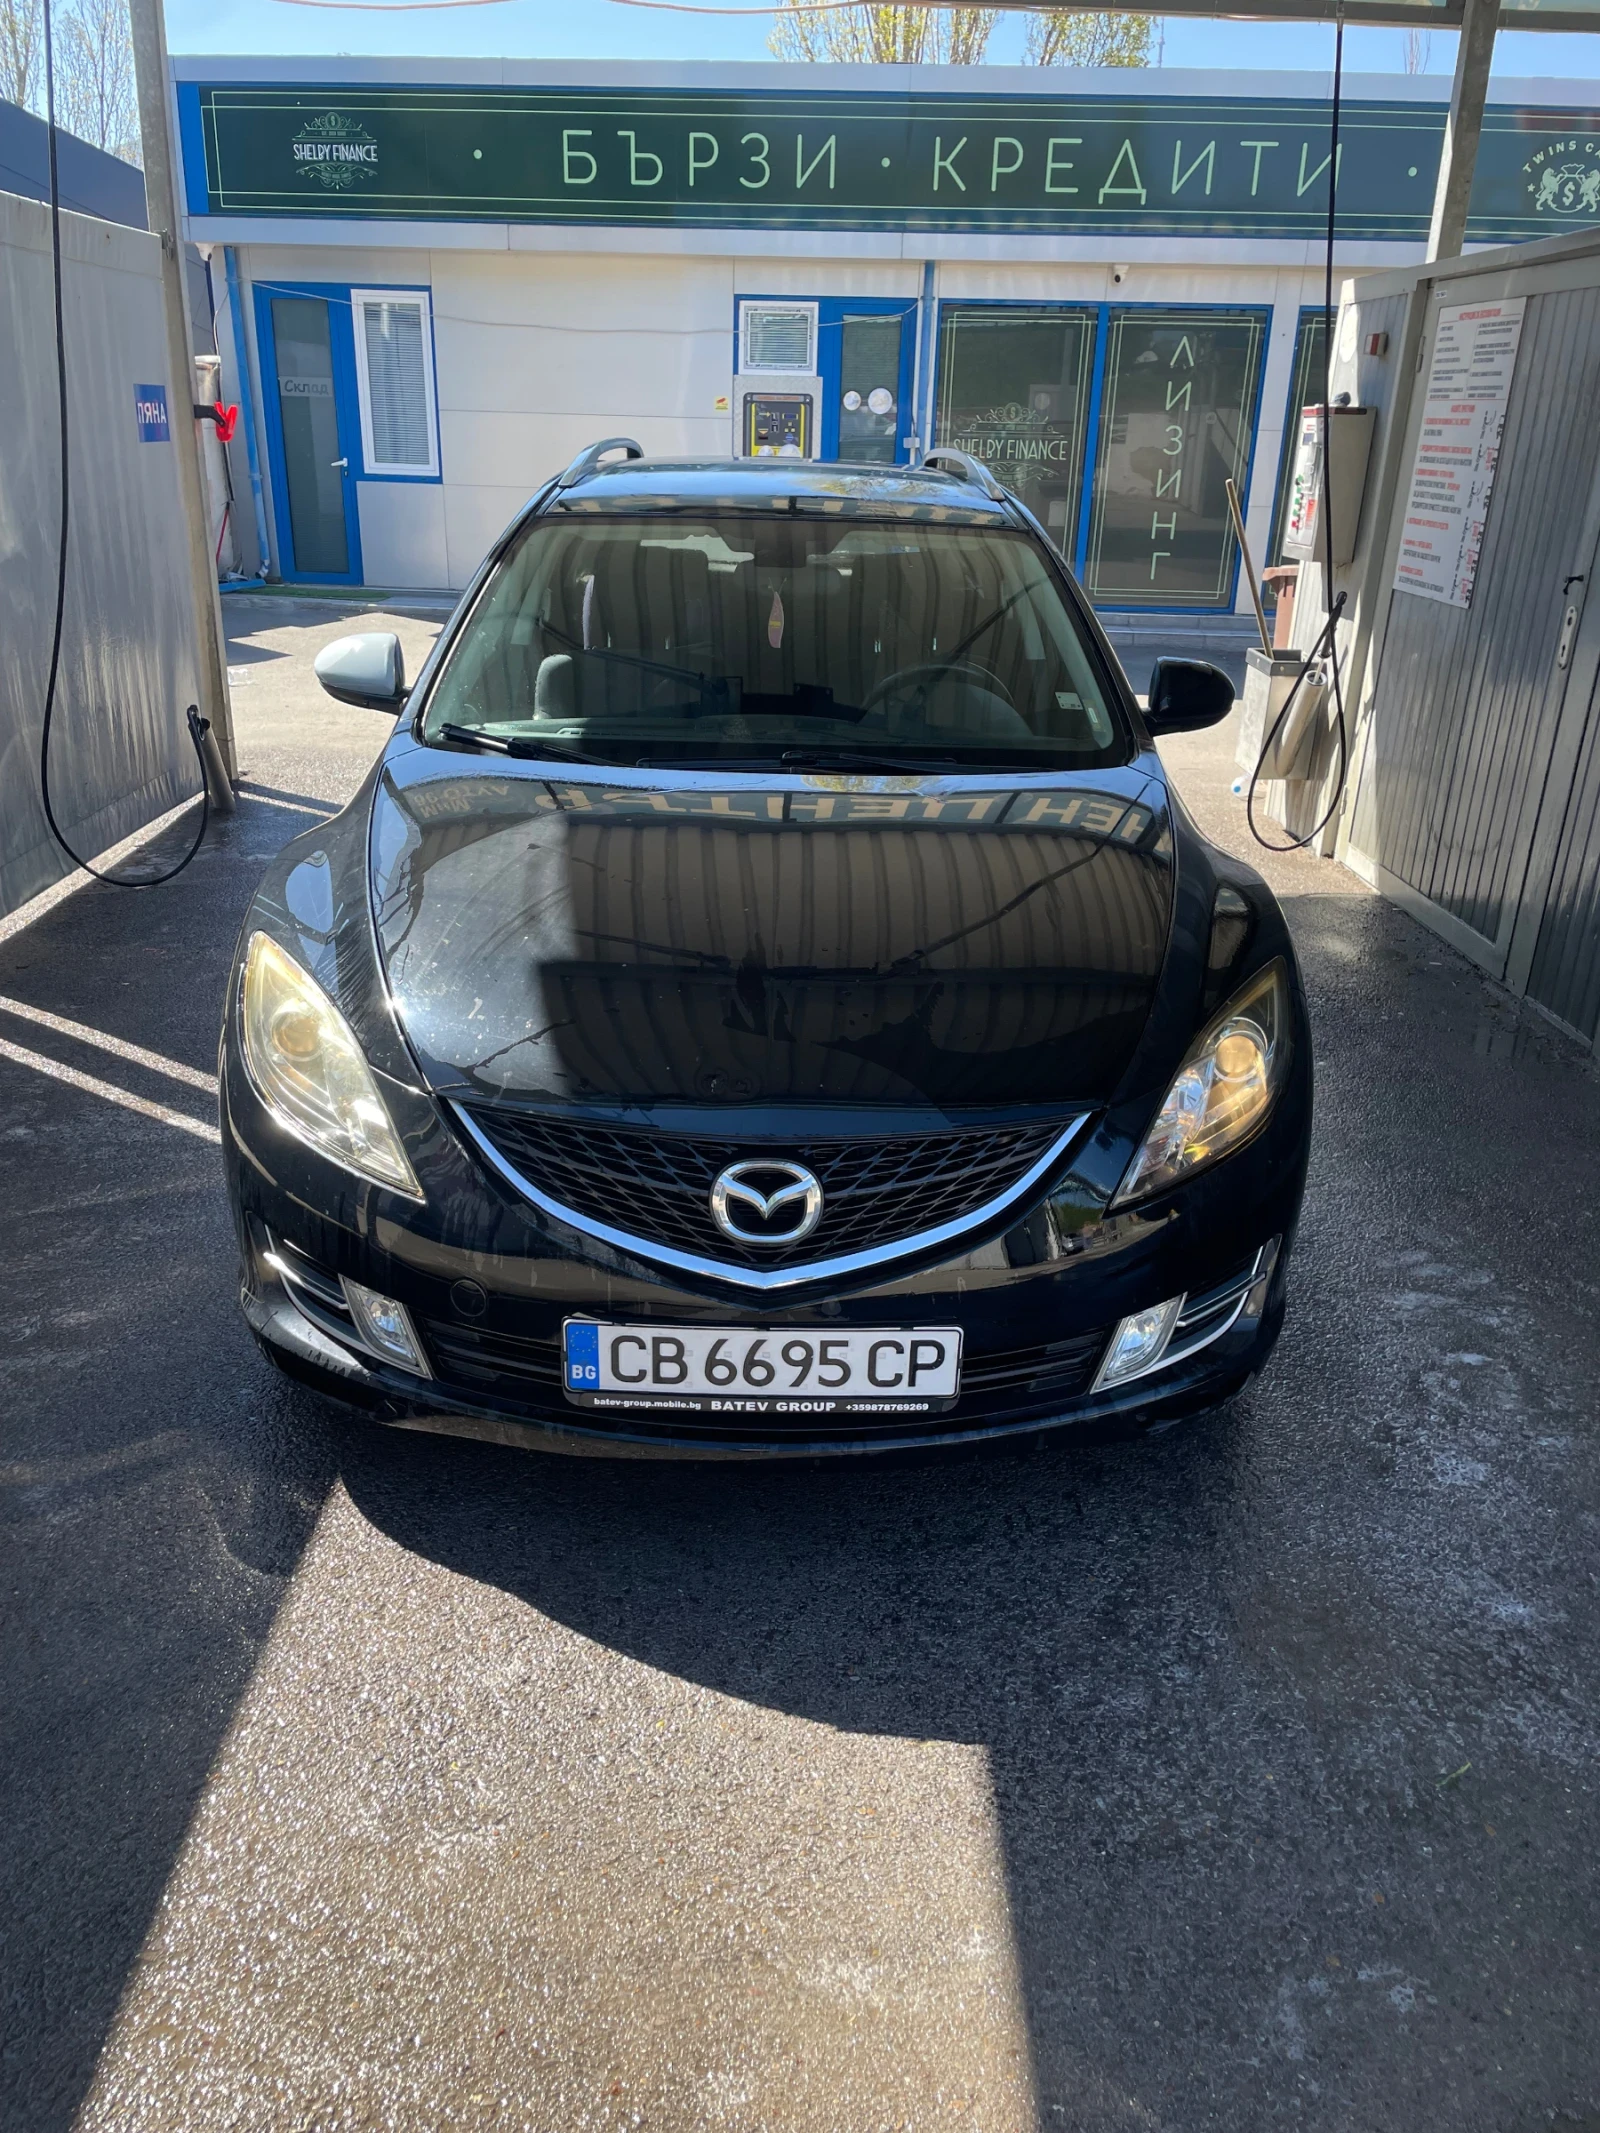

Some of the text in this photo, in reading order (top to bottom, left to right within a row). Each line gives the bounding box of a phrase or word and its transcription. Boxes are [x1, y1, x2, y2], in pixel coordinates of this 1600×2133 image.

[293, 143, 378, 162] SHELBY FINANCE
[1522, 140, 1577, 173] TWINS
[562, 129, 1342, 205] БЪРЗИ КРЕДИТИ
[284, 379, 330, 396] Склад
[136, 402, 167, 425] ПЯНА
[953, 438, 1069, 461] SHELBY FINANCE
[1149, 335, 1195, 580] ЛИЗИНГ
[572, 1365, 597, 1380] BG
[611, 1335, 946, 1388] CB 6695 CP
[594, 1397, 929, 1412] batev-group.mobile.bg BATEV GROUP +359878769269
